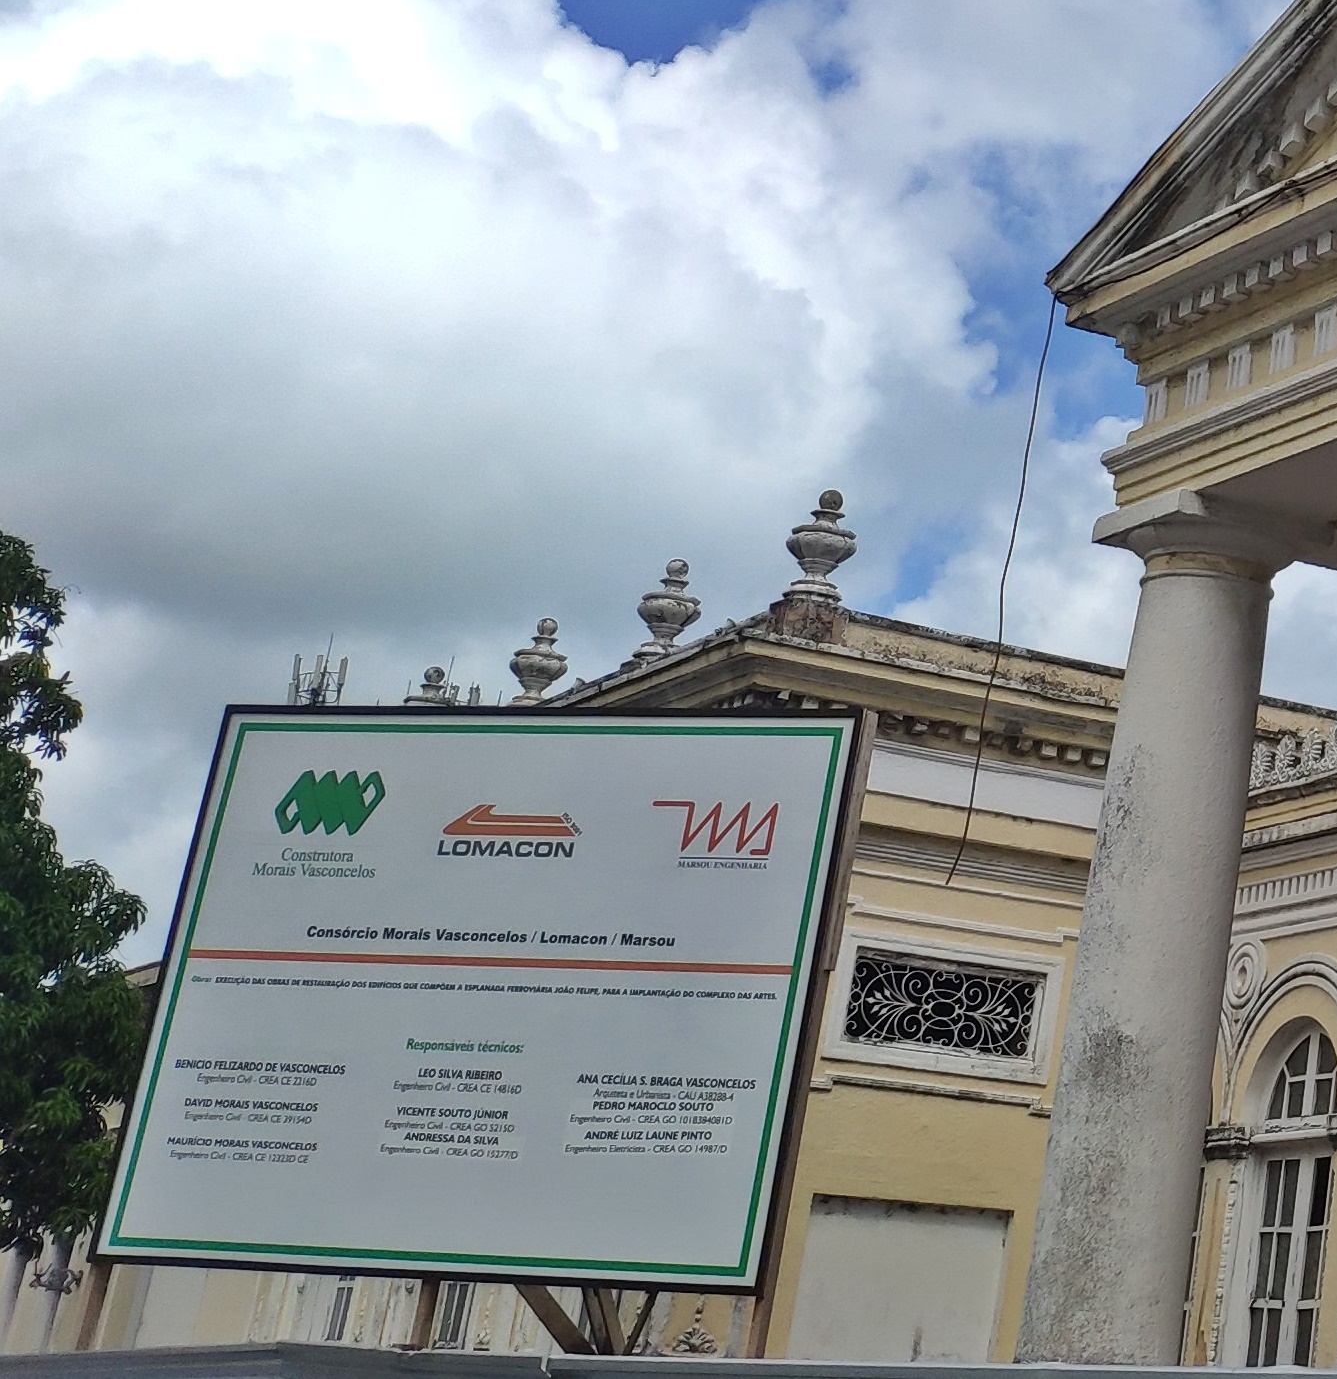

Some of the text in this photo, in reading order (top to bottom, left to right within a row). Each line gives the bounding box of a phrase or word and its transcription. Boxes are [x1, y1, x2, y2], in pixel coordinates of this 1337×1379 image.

[281, 847, 354, 862] Construtora
[437, 840, 575, 858] LOMACON
[252, 862, 376, 879] Morais Vasconcelos
[678, 861, 767, 870] MARSOU ENGENHARIA
[307, 925, 378, 940] Consórcio
[383, 927, 430, 941] Morais
[436, 929, 527, 943] Vasconcelos
[539, 931, 608, 945] Lomacon
[620, 933, 676, 947] Marsou
[215, 976, 250, 985] EXECUÇÃO
[267, 978, 290, 986] OBRAS
[302, 979, 350, 989] RESTAURAÇÃO
[465, 984, 505, 992] ESPLANADA
[507, 985, 552, 993] FERROVIÁRIA
[554, 985, 574, 994] JOÃO
[630, 988, 681, 998] IMPLANTAÇÃO
[696, 991, 735, 999] COMPLEXO
[406, 1038, 524, 1054] Responsáveis técnicos:
[213, 1060, 263, 1072] FELIZARDO
[265, 1062, 277, 1072] DE
[279, 1063, 346, 1075] VASCONCELOS
[197, 1073, 235, 1084] Engenheiro
[237, 1074, 251, 1084] Civil
[258, 1075, 279, 1085] CREA
[281, 1076, 292, 1085] CE
[418, 1068, 503, 1081] LEO SILVA RIBEIRO
[576, 1072, 756, 1089] ANA CECÍLIA S. BRAGA VASCONCELOS
[393, 1080, 433, 1092] Engenheiro
[435, 1082, 451, 1091] Civil
[457, 1082, 478, 1093] CREA
[480, 1084, 492, 1093] CE
[677, 1091, 696, 1100] CAU
[184, 1098, 319, 1112] DAVID MORAIS VASCONCELOS
[593, 1101, 626, 1111] PEDRO
[678, 1102, 714, 1111] SOUTO
[248, 1113, 269, 1123] CREA
[271, 1114, 281, 1123] CE
[397, 1106, 509, 1120] VICENTE SOUTO JÚNIOR
[570, 1114, 612, 1125] Engenheiro
[614, 1115, 631, 1123] Civil
[637, 1115, 660, 1123] CREA
[662, 1115, 676, 1124] GO
[427, 1121, 443, 1130] Civil
[450, 1122, 471, 1131] CREA
[474, 1123, 487, 1132] GO
[404, 1132, 499, 1145] ANDRESSA DA SILVA
[584, 1128, 712, 1141] ANDRÉ LUIZ LAUNE PINTO
[167, 1136, 318, 1151] MAURÍCIO MORAIS VASCONCELOS
[565, 1144, 607, 1155] Engenheiro
[652, 1145, 676, 1153] CREA
[678, 1145, 692, 1153] GO
[232, 1152, 253, 1161] CREA
[255, 1153, 266, 1162] CE
[446, 1147, 468, 1156] CREA
[470, 1148, 485, 1157] GO
